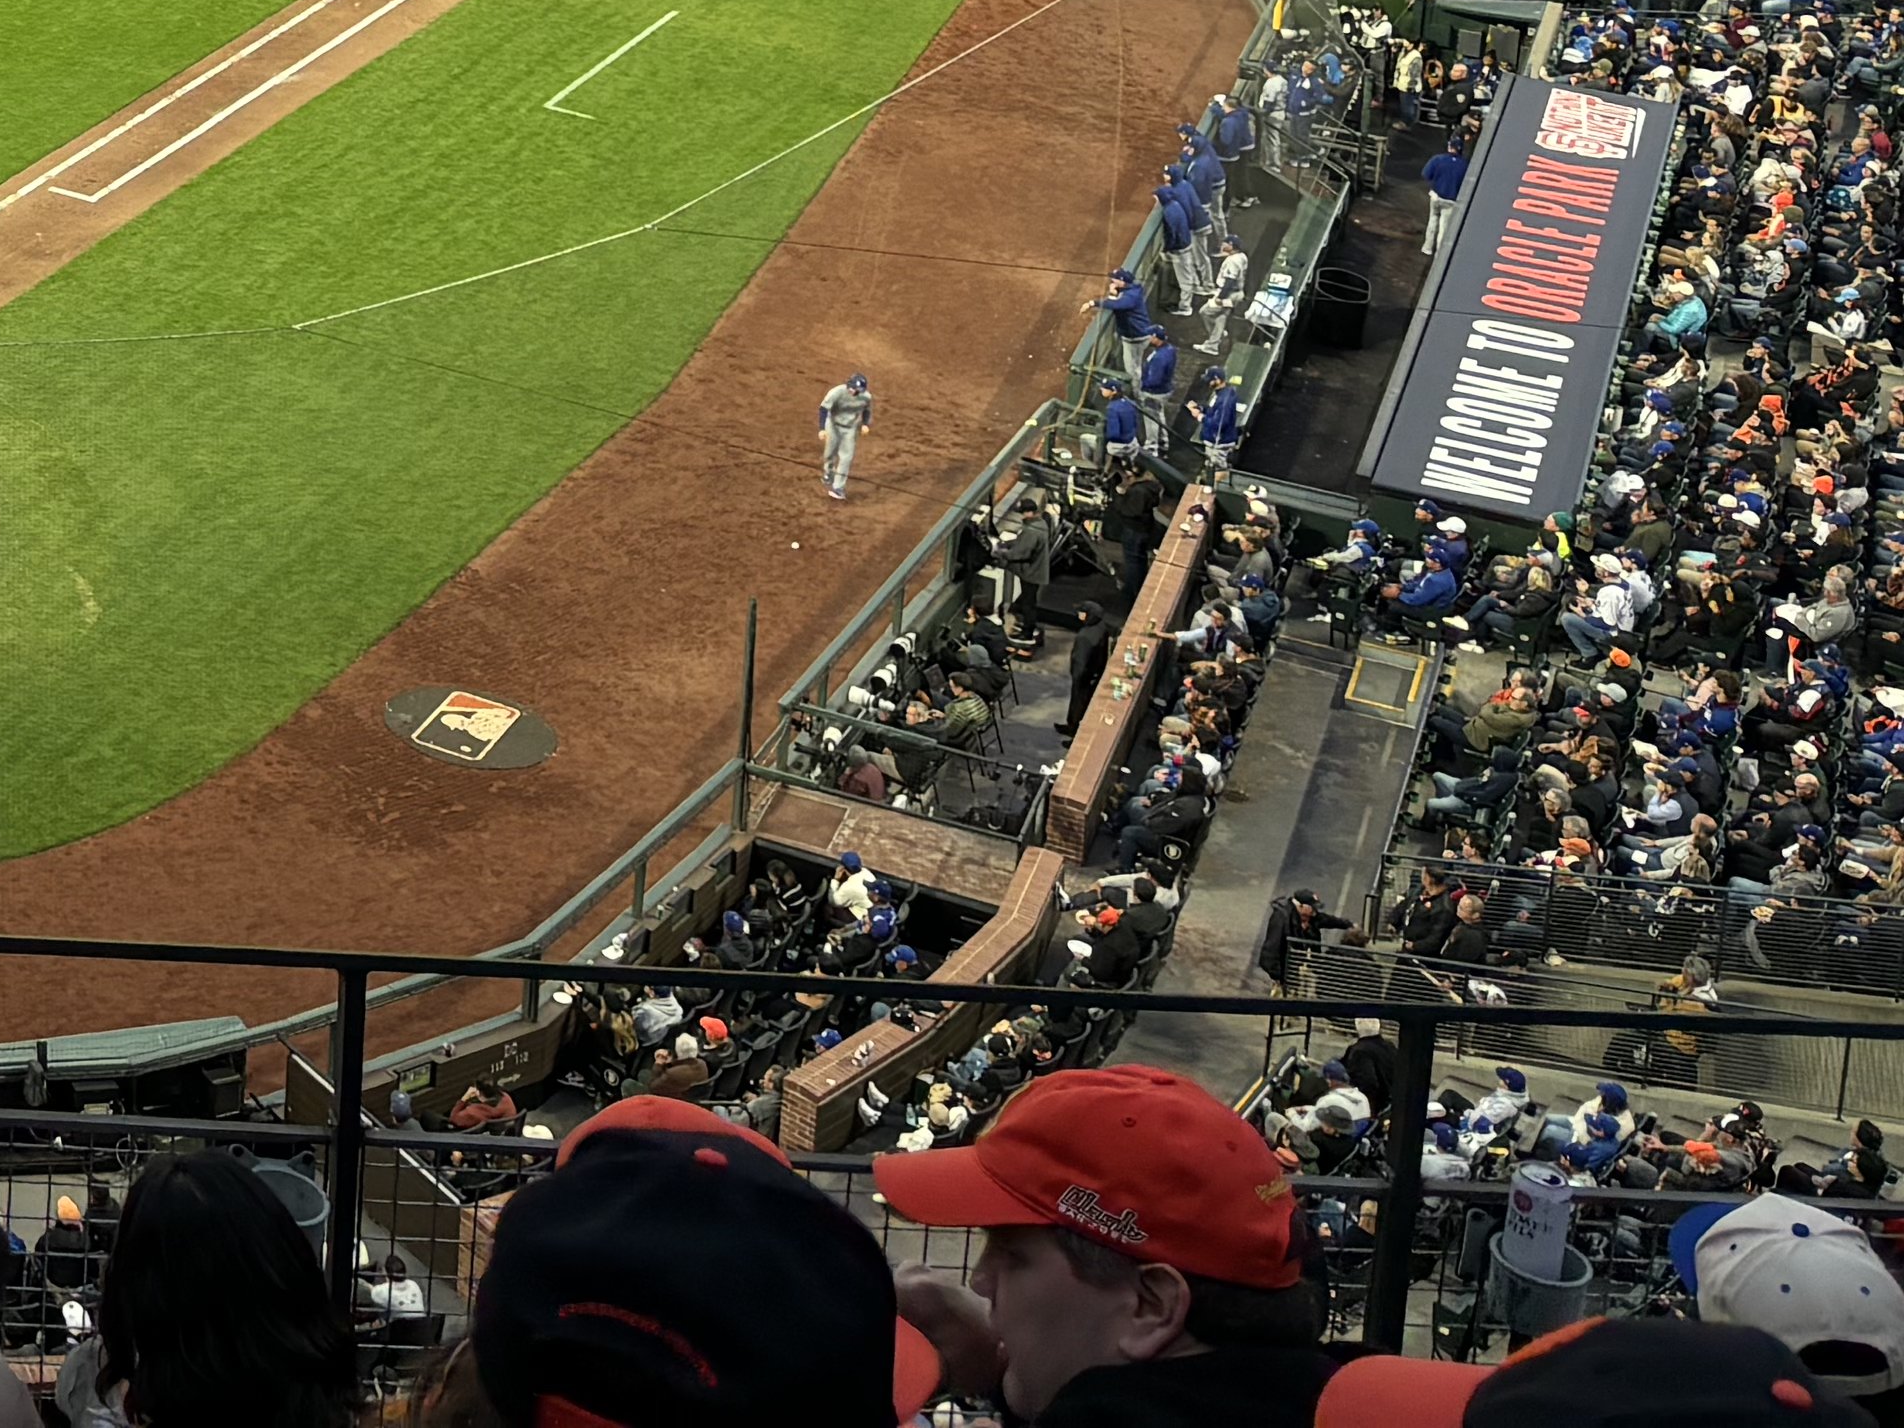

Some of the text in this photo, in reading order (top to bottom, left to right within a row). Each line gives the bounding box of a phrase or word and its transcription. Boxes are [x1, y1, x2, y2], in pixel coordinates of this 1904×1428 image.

[1512, 154, 1620, 226] PARK
[1481, 219, 1602, 323] ORACLE
[1466, 319, 1575, 364] TO
[1420, 357, 1564, 505] WELCOME
